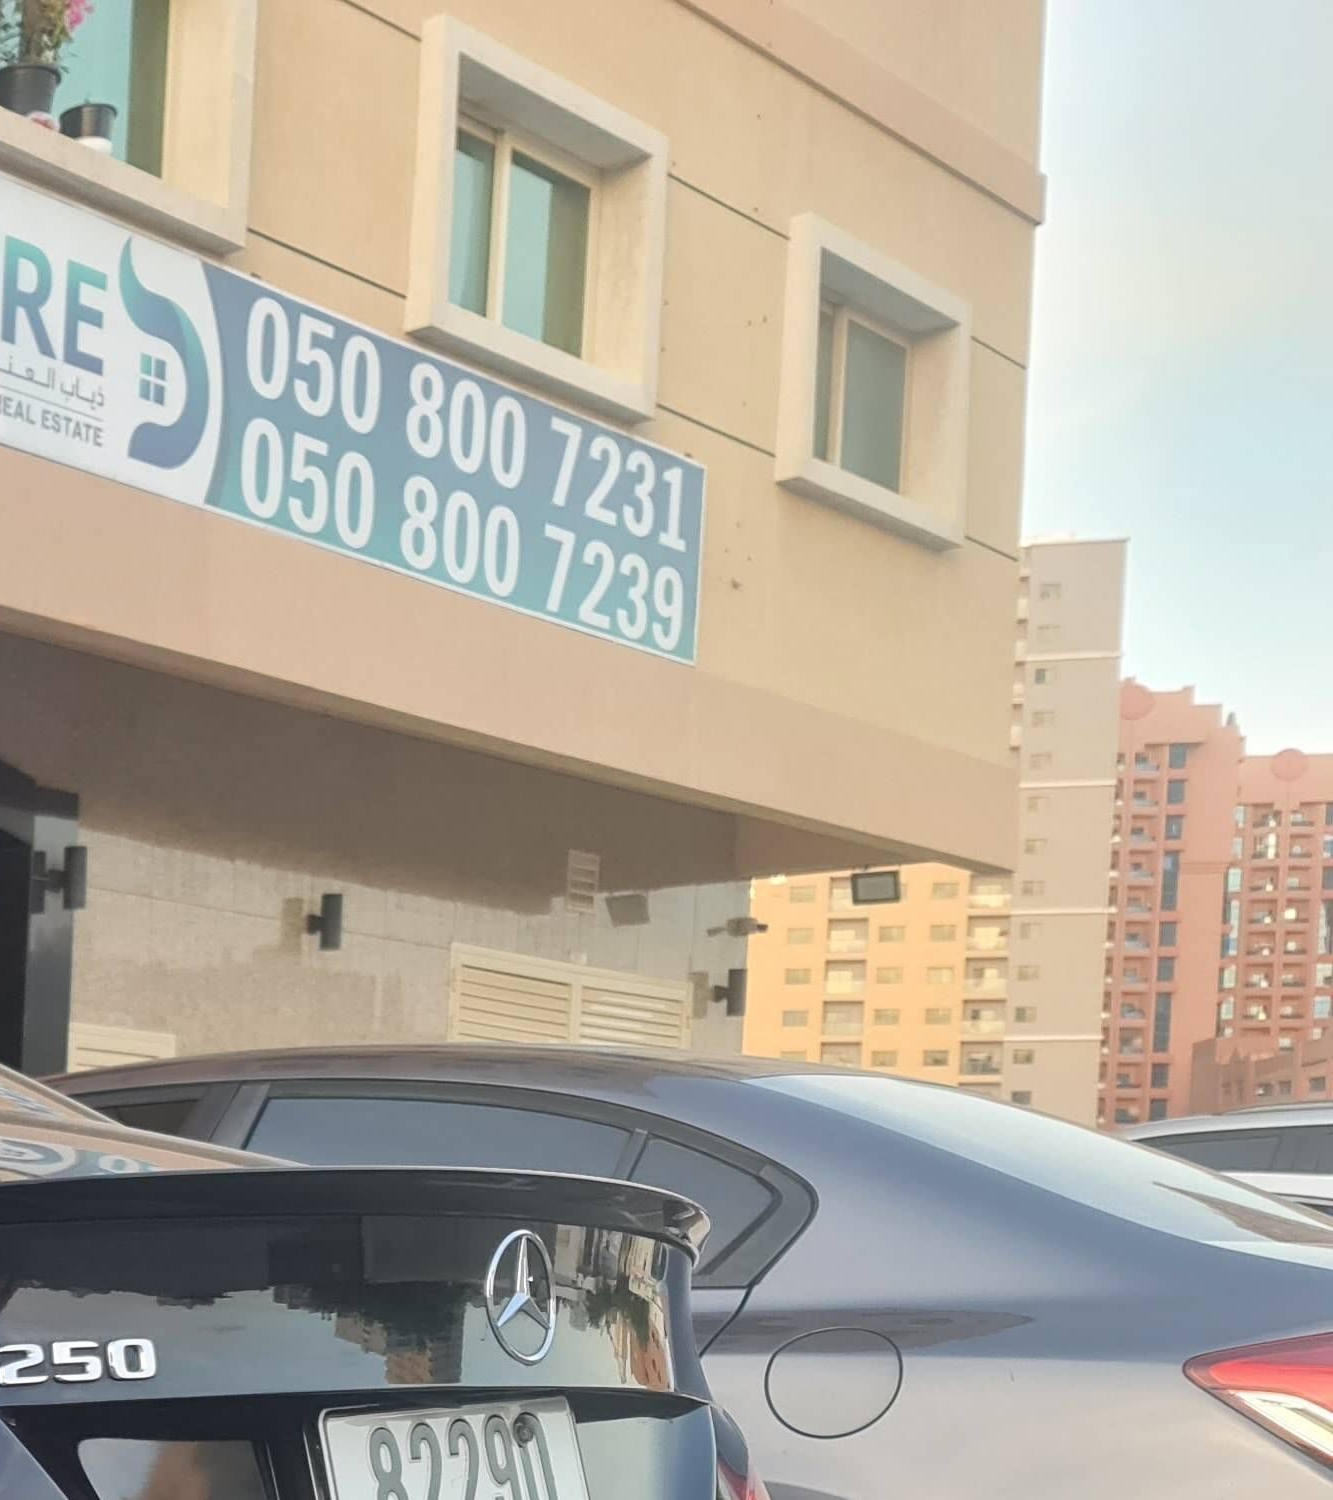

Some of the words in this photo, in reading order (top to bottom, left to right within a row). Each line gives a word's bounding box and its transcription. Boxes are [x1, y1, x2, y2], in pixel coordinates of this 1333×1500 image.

[41, 410, 104, 448] ESTATE
[240, 416, 376, 551] 050
[399, 475, 521, 599] 800
[544, 525, 685, 652] 7239
[246, 296, 382, 436] 050
[406, 362, 527, 490] 800
[550, 422, 687, 552] 7231
